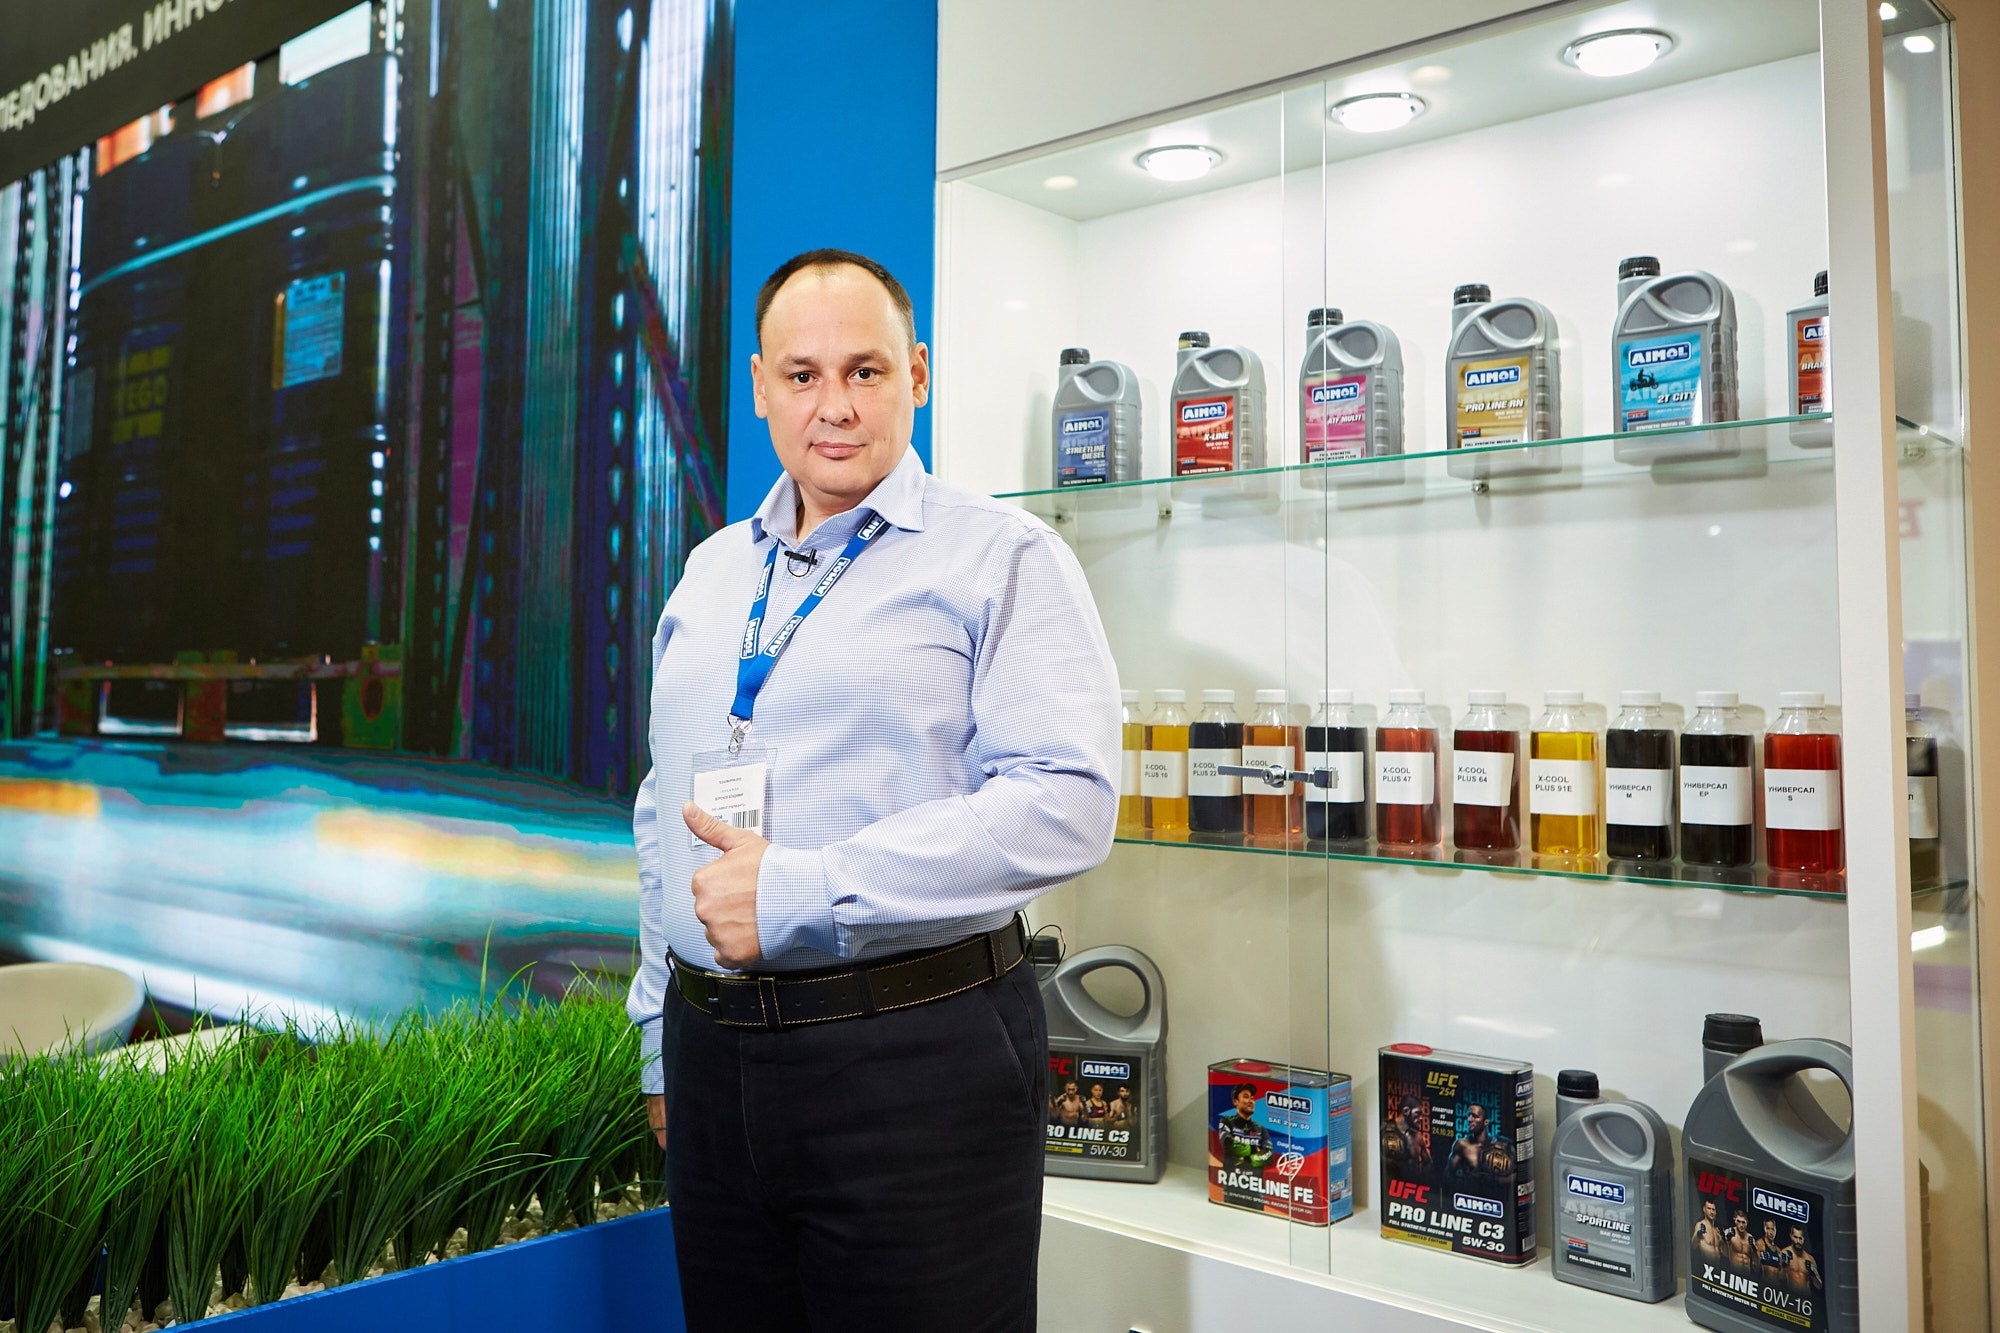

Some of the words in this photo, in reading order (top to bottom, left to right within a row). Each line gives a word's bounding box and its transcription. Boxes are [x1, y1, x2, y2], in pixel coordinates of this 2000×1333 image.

[1632, 346, 1688, 365] AIMOL
[1468, 369, 1518, 385] AIMOL
[1314, 386, 1357, 402] AIMOL
[1657, 393, 1670, 404] 2T
[1672, 391, 1696, 401] CITY
[1185, 406, 1225, 419] AIMOL
[1465, 403, 1485, 413] PRO
[1486, 400, 1507, 411] LINE
[1510, 399, 1524, 408] RN
[1065, 420, 1101, 432] AIMOL
[1204, 432, 1230, 441] X-LINE
[1066, 445, 1105, 455] STREETLINE
[1082, 452, 1105, 460] DIESEL
[816, 561, 848, 595] AIMOL
[769, 619, 798, 655] AIMOL
[1538, 775, 1569, 783] X-COOL
[1048, 1057, 1072, 1075] FC
[1084, 1064, 1127, 1076] AIMOL
[1427, 1071, 1459, 1088] UFC
[1439, 1087, 1455, 1097] 254
[1268, 1094, 1309, 1110] AIMOL
[1047, 1124, 1065, 1137] RO
[1068, 1127, 1104, 1141] LINE
[1108, 1130, 1130, 1143] C3
[1090, 1144, 1127, 1157] 5W-30
[1217, 1169, 1289, 1199] RACELINE
[1294, 1186, 1313, 1204] FE
[1388, 1179, 1430, 1204] UFC
[1570, 1178, 1623, 1199] AIMOL
[1698, 1170, 1743, 1203] UFC
[1457, 1197, 1500, 1213] AIMOL
[1756, 1193, 1806, 1217] AIMOL
[1389, 1202, 1426, 1223] PRO
[1430, 1211, 1473, 1234] LINE
[1478, 1221, 1505, 1240] C3
[1576, 1213, 1631, 1233] SPORTLINE
[1462, 1236, 1505, 1252] 5W-30
[1702, 1283, 1712, 1292] FULL
[1712, 1287, 1734, 1300] SYNTHETIC
[1703, 1263, 1758, 1298] X-LINE
[1763, 1286, 1812, 1316] 0W-16
